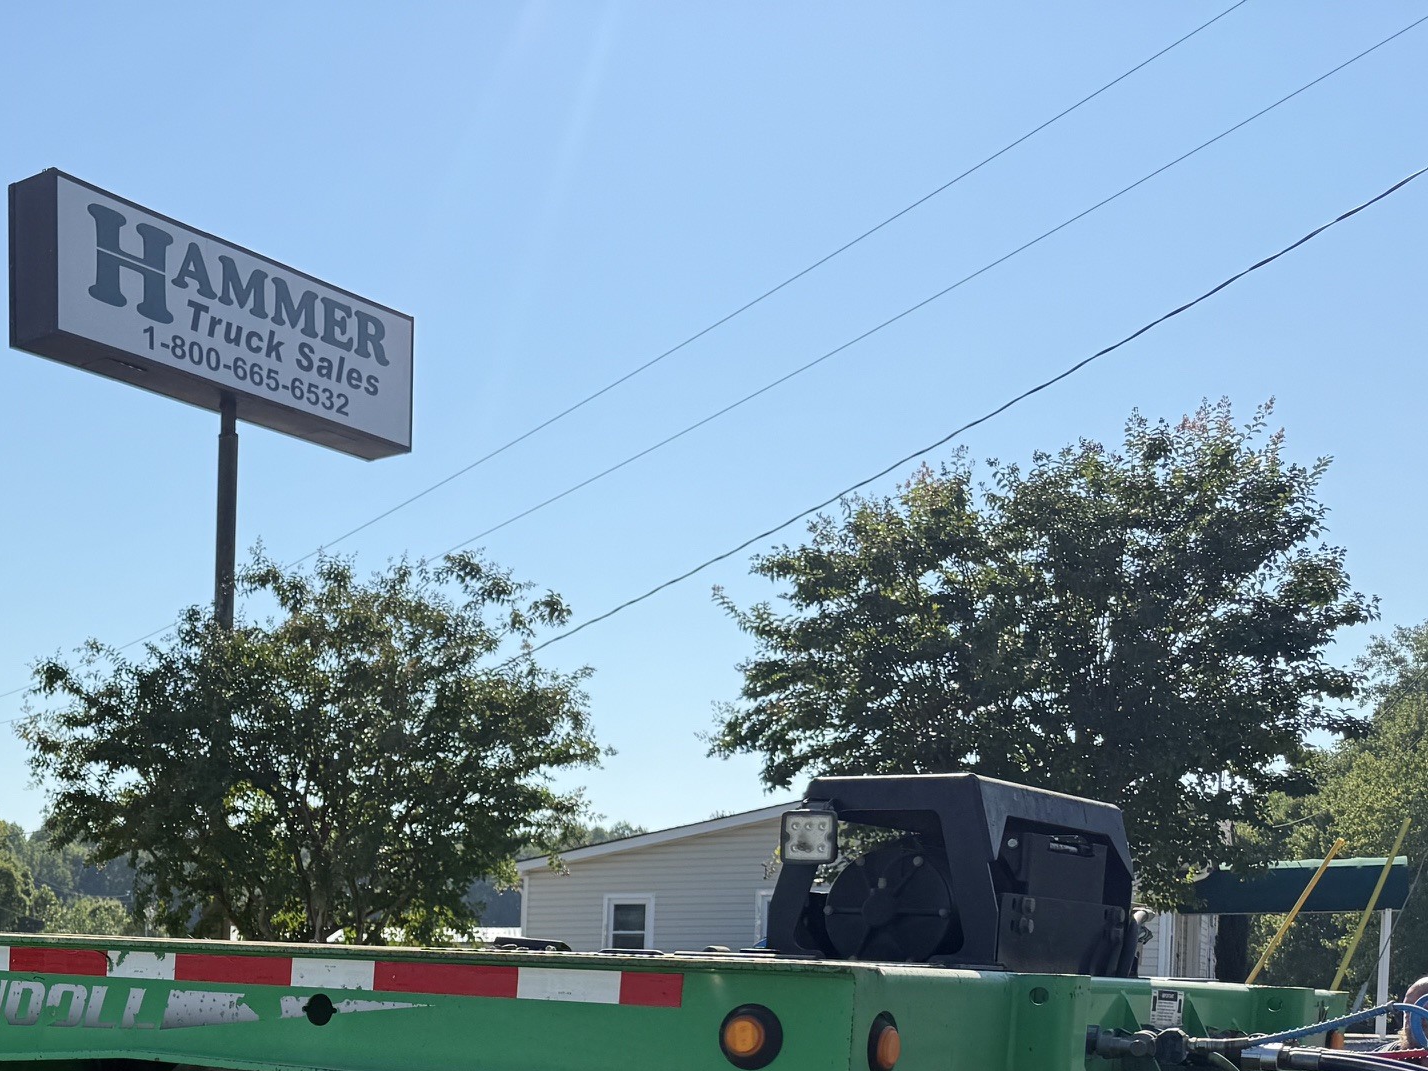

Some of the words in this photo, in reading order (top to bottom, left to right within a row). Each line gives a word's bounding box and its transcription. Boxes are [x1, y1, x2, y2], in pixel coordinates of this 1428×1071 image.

[87, 203, 390, 367] HAMMER
[142, 325, 350, 417] 1-800-665-6532
[187, 300, 283, 363] Truck
[296, 342, 380, 397] Sales
